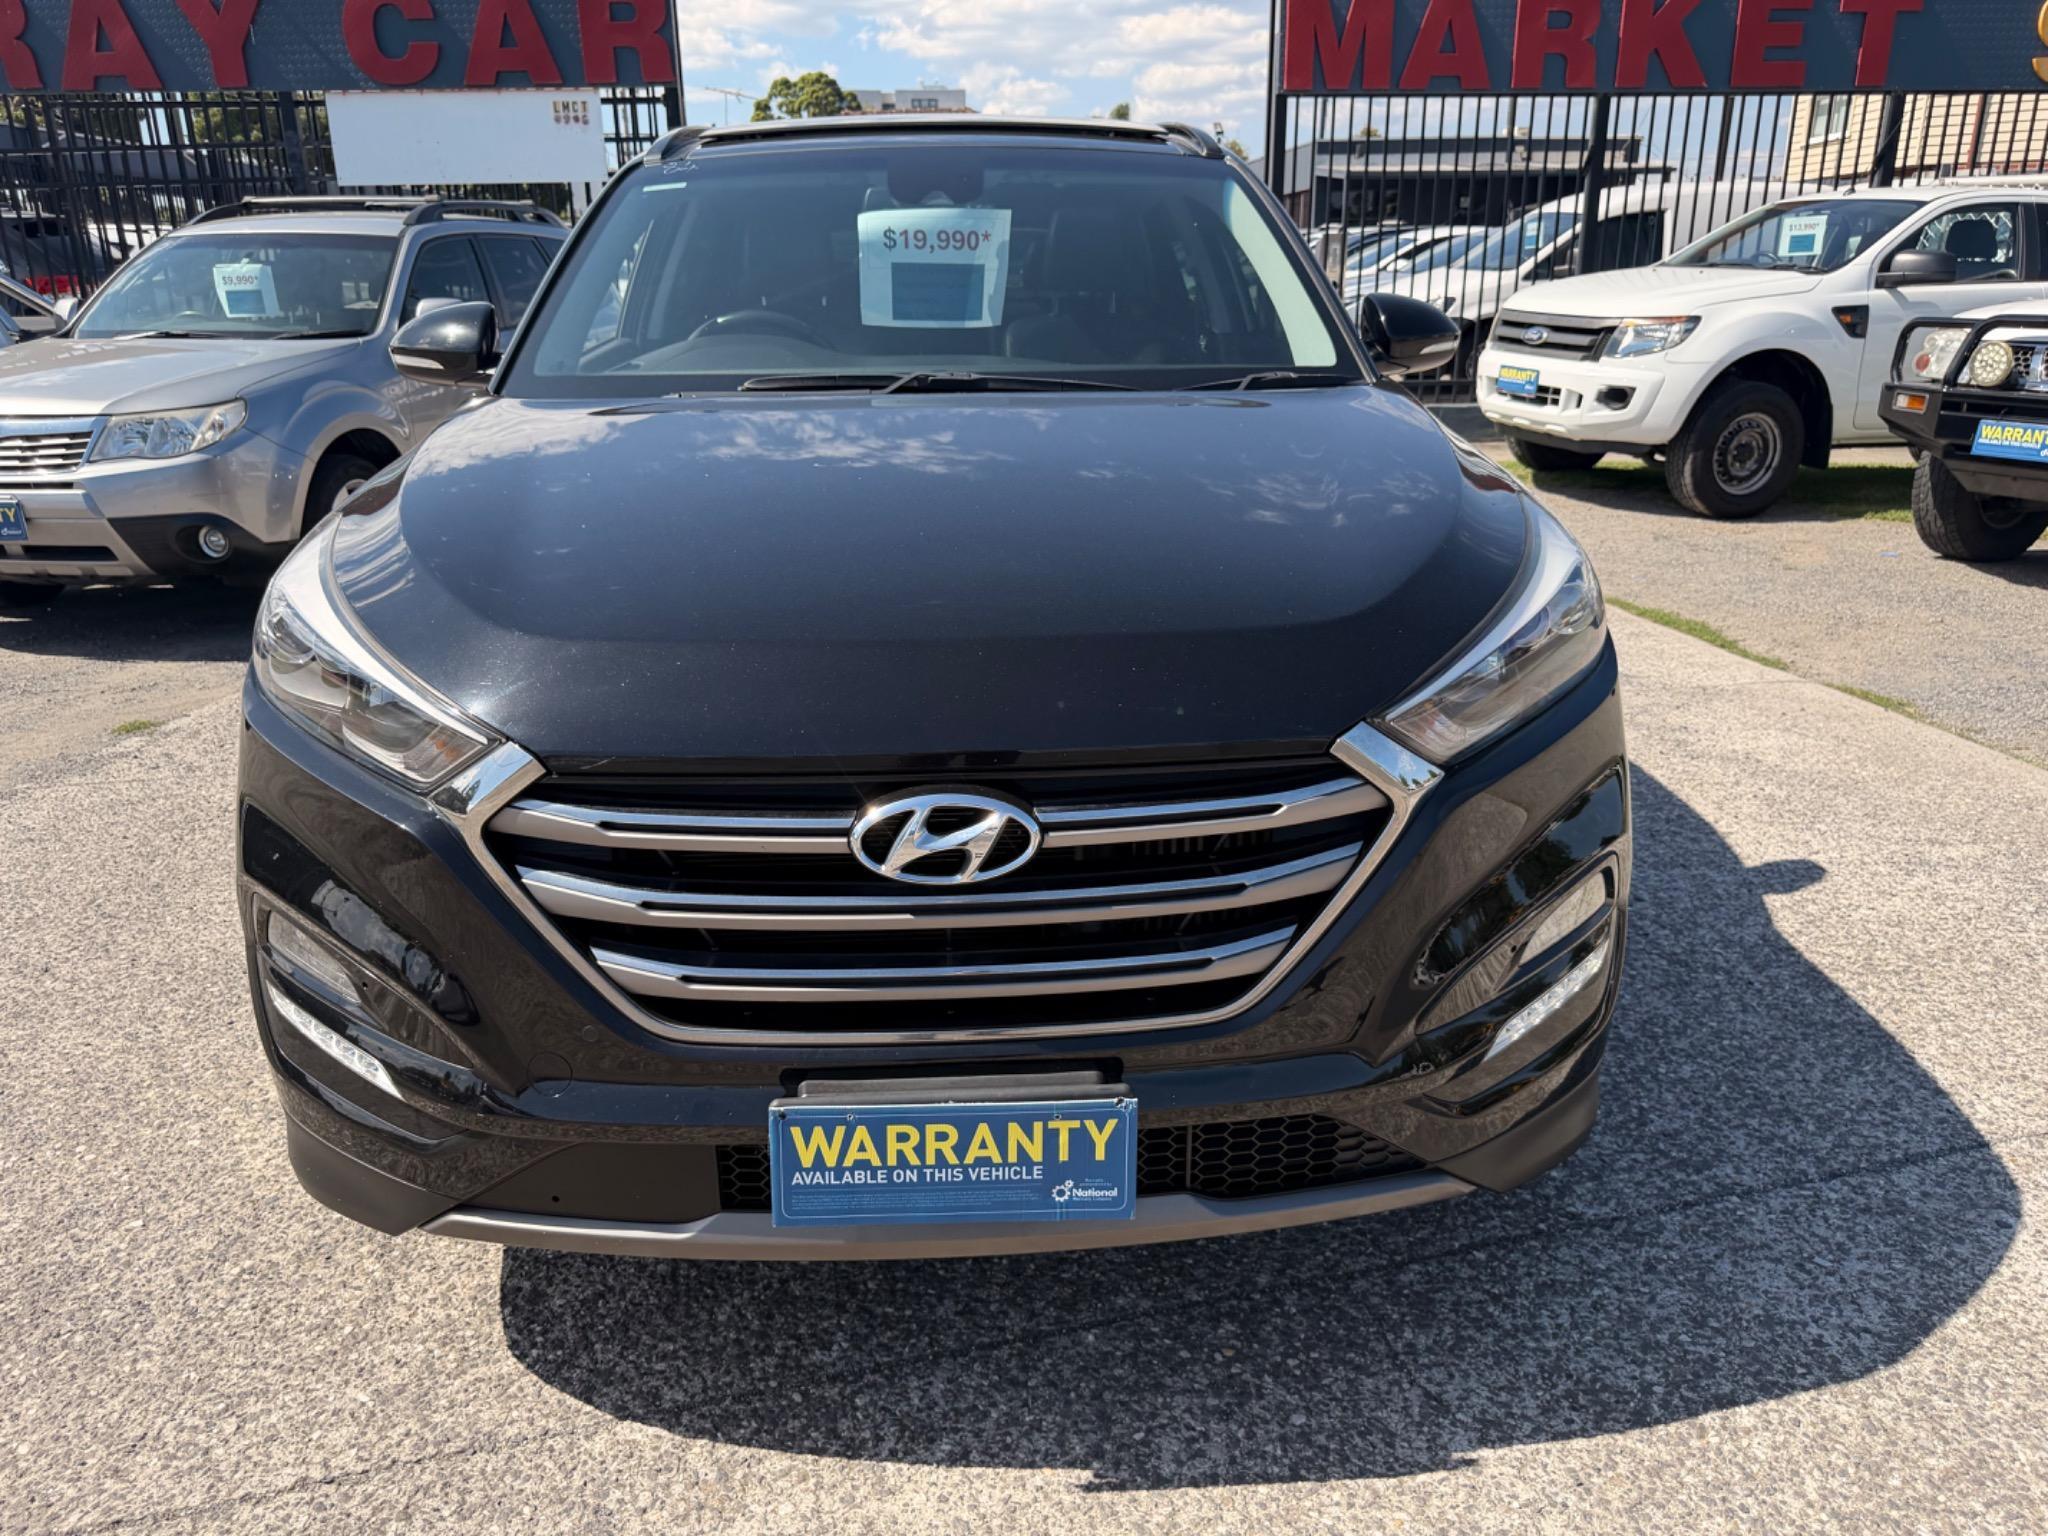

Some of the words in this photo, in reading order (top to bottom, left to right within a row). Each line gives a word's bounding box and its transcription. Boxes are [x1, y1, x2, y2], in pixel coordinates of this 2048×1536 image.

[342, 0, 673, 86] CAR
[1283, 0, 1924, 90] MARKET
[552, 100, 588, 113] LMCT
[789, 1118, 1118, 1168] WARRANTY
[791, 1169, 888, 1186] AVAILABLE
[893, 1169, 918, 1183] ON
[923, 1167, 963, 1182] THIS
[967, 1165, 1043, 1181] VEHICLE
[1072, 1187, 1118, 1197] National
